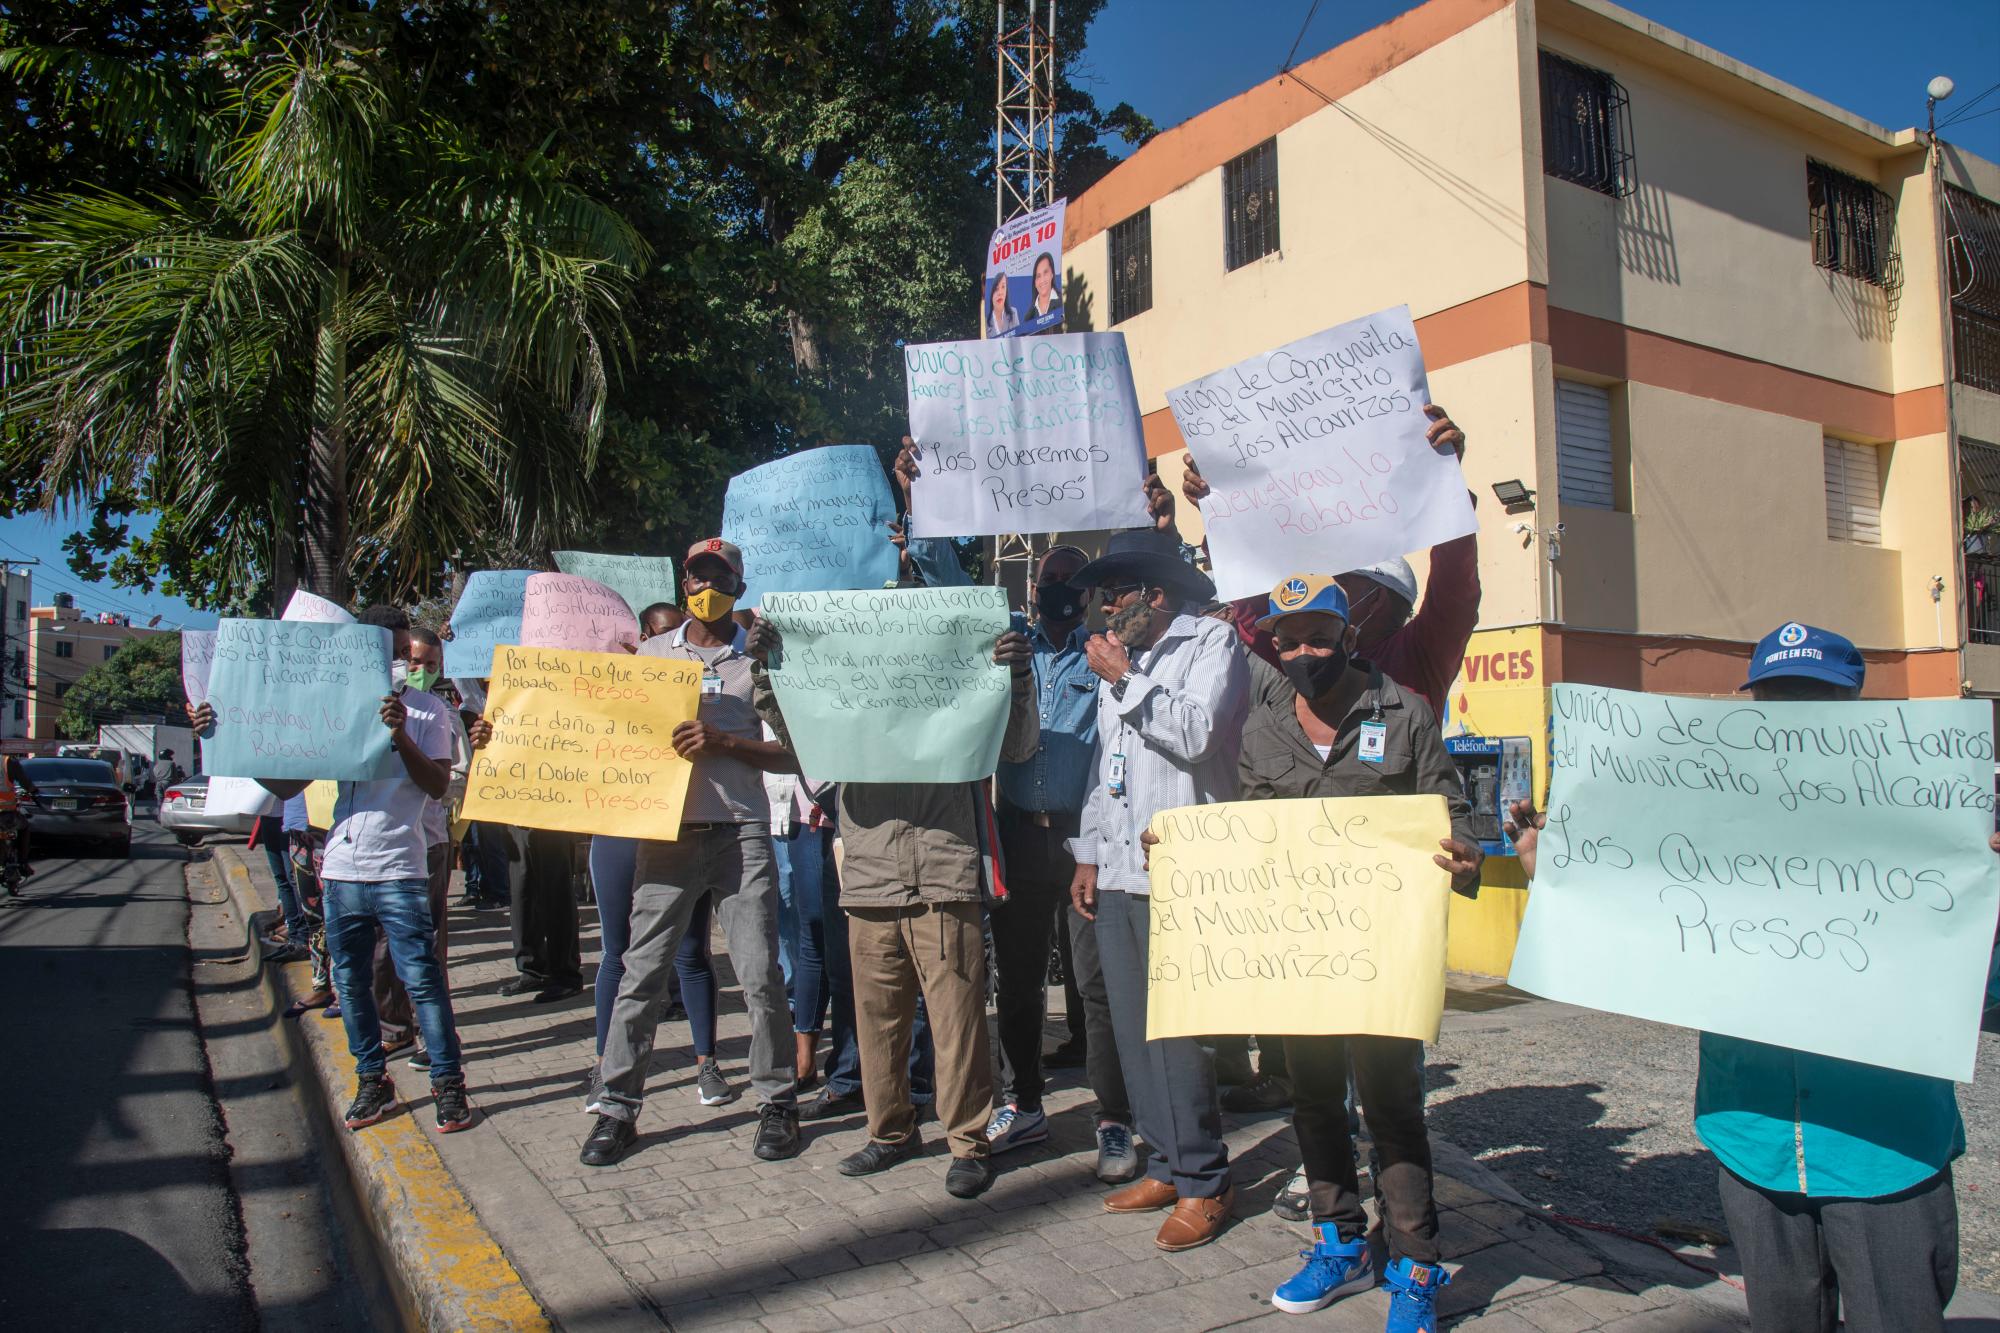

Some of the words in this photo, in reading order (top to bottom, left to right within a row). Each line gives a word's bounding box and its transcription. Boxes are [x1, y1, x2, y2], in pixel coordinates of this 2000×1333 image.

[993, 232, 1031, 265] VOTA
[1036, 222, 1056, 243] 10
[992, 351, 1028, 377] de
[970, 377, 996, 399] del
[1234, 368, 1271, 399] de
[1184, 416, 1215, 438] ios
[1221, 408, 1252, 430] del
[1342, 446, 1391, 477] lo
[728, 510, 745, 528] Por
[751, 504, 762, 518] el
[770, 497, 800, 515] mal
[1271, 480, 1398, 535] Robado
[749, 524, 769, 537] los
[824, 591, 848, 613] de
[269, 623, 295, 647] de
[245, 646, 271, 661] del
[507, 649, 527, 671] Por
[535, 657, 571, 673] todo
[802, 648, 818, 666] el
[951, 649, 979, 668] de
[1465, 650, 1534, 682] VICES
[1764, 650, 1788, 665] PONTE
[1789, 649, 1801, 658] EN
[574, 677, 650, 703] Presos
[323, 704, 345, 732] lo
[492, 707, 515, 727] Por
[549, 710, 595, 734] daño
[605, 719, 615, 735] a
[627, 721, 653, 735] los
[1657, 700, 1716, 745] de
[594, 739, 677, 762] Presos
[476, 757, 500, 777] Por
[538, 762, 589, 782] Doble
[602, 767, 656, 784] Dolor
[1777, 758, 1846, 811] Los
[585, 789, 669, 810] Presos
[1308, 799, 1377, 848] de
